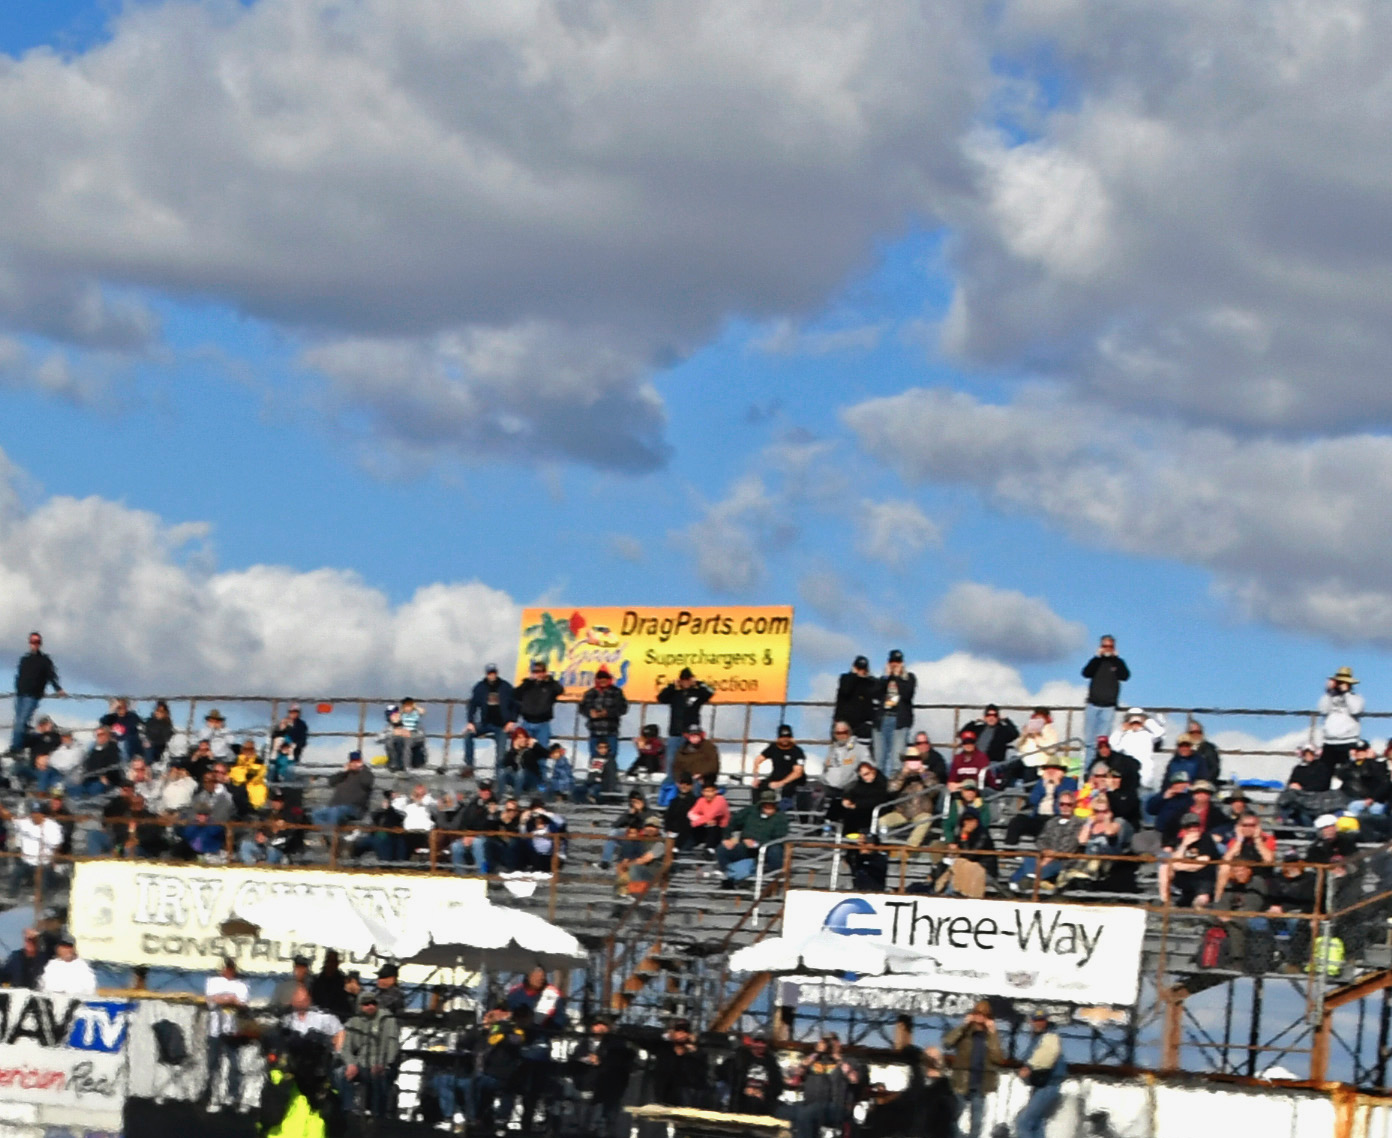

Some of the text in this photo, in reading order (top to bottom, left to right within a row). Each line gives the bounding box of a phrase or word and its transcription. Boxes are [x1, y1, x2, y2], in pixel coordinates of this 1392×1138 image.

[621, 611, 790, 642] DragParts.com
[644, 649, 774, 668] Superchargers &
[885, 900, 1105, 967] Three-Way
